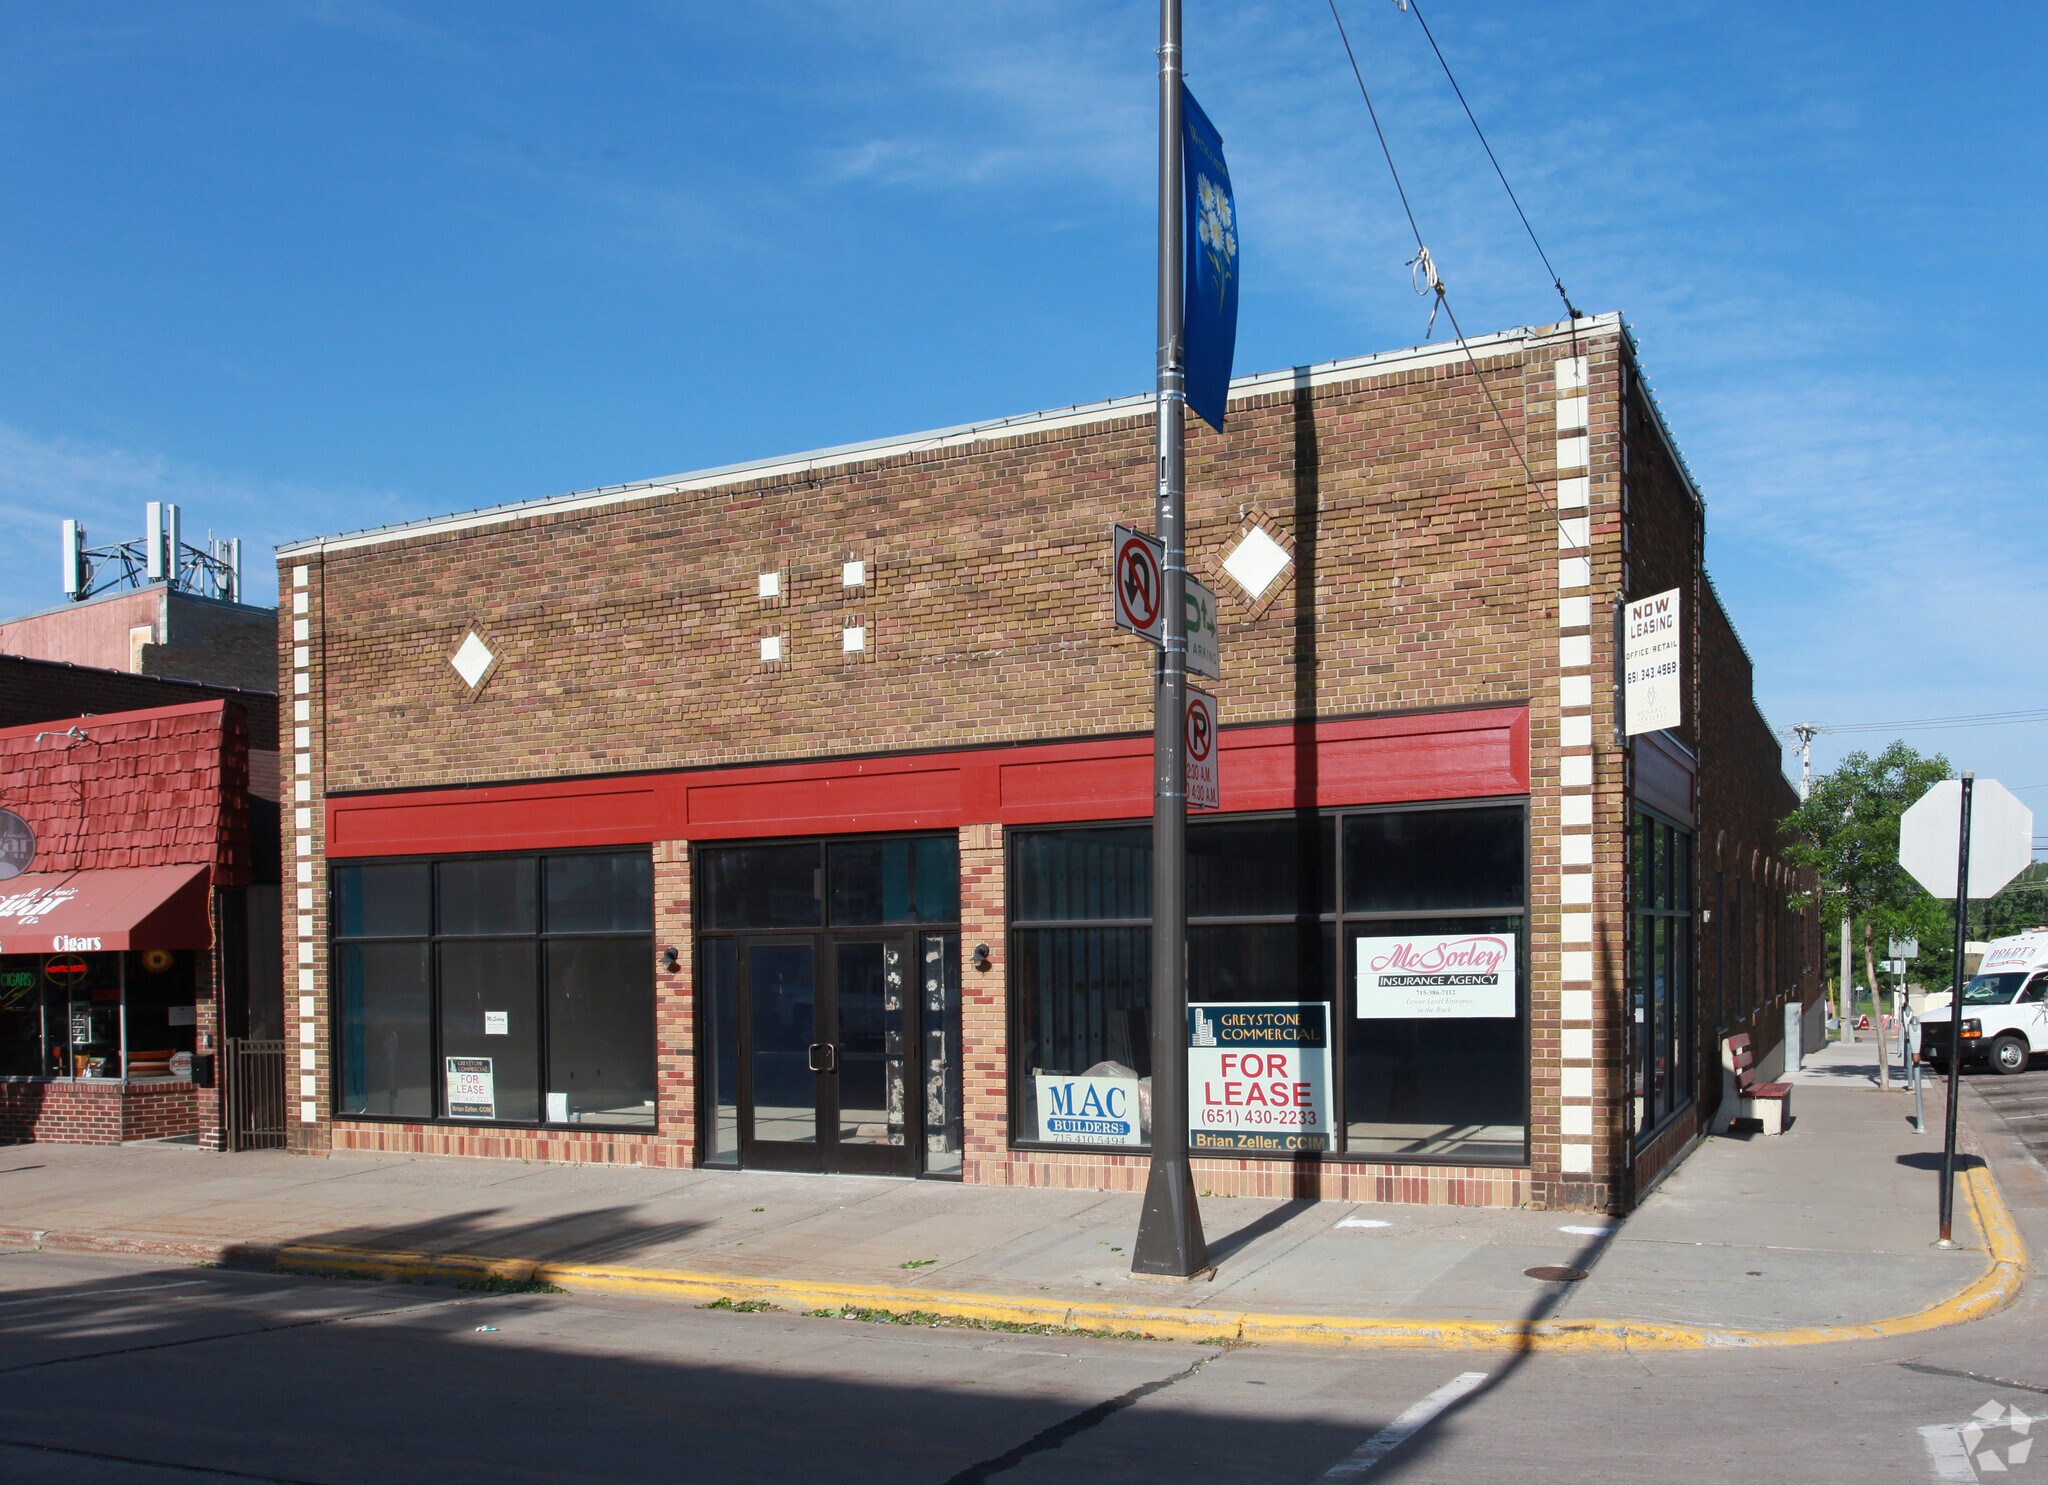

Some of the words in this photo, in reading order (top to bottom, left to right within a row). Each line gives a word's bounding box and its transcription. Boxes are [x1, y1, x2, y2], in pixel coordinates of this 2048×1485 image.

[1633, 597, 1669, 621] NOW
[1631, 613, 1673, 639] LEASING
[1626, 647, 1649, 660] OFFICE
[1652, 639, 1678, 654] RETAIL
[53, 935, 101, 952] Cigars
[1370, 936, 1508, 976] McSorley
[1, 972, 32, 987] CIGARS
[1380, 975, 1445, 986] INSURANCE
[1447, 974, 1497, 985] AGENCY
[1427, 997, 1444, 1005] Level
[1221, 1013, 1302, 1026] GREYSTONE
[1221, 1028, 1321, 1041] COMMERCIAL
[1220, 1053, 1288, 1079] FOR
[461, 1074, 479, 1083] FOR
[457, 1085, 484, 1094] LEASE
[1204, 1081, 1312, 1107] LEASE
[1048, 1082, 1127, 1118] MAC
[1201, 1109, 1239, 1127] (651)
[1244, 1110, 1317, 1125] 430-2233
[1053, 1119, 1119, 1134] BUILDERS
[1196, 1133, 1233, 1147] Brian
[1285, 1136, 1325, 1149] CCIM
